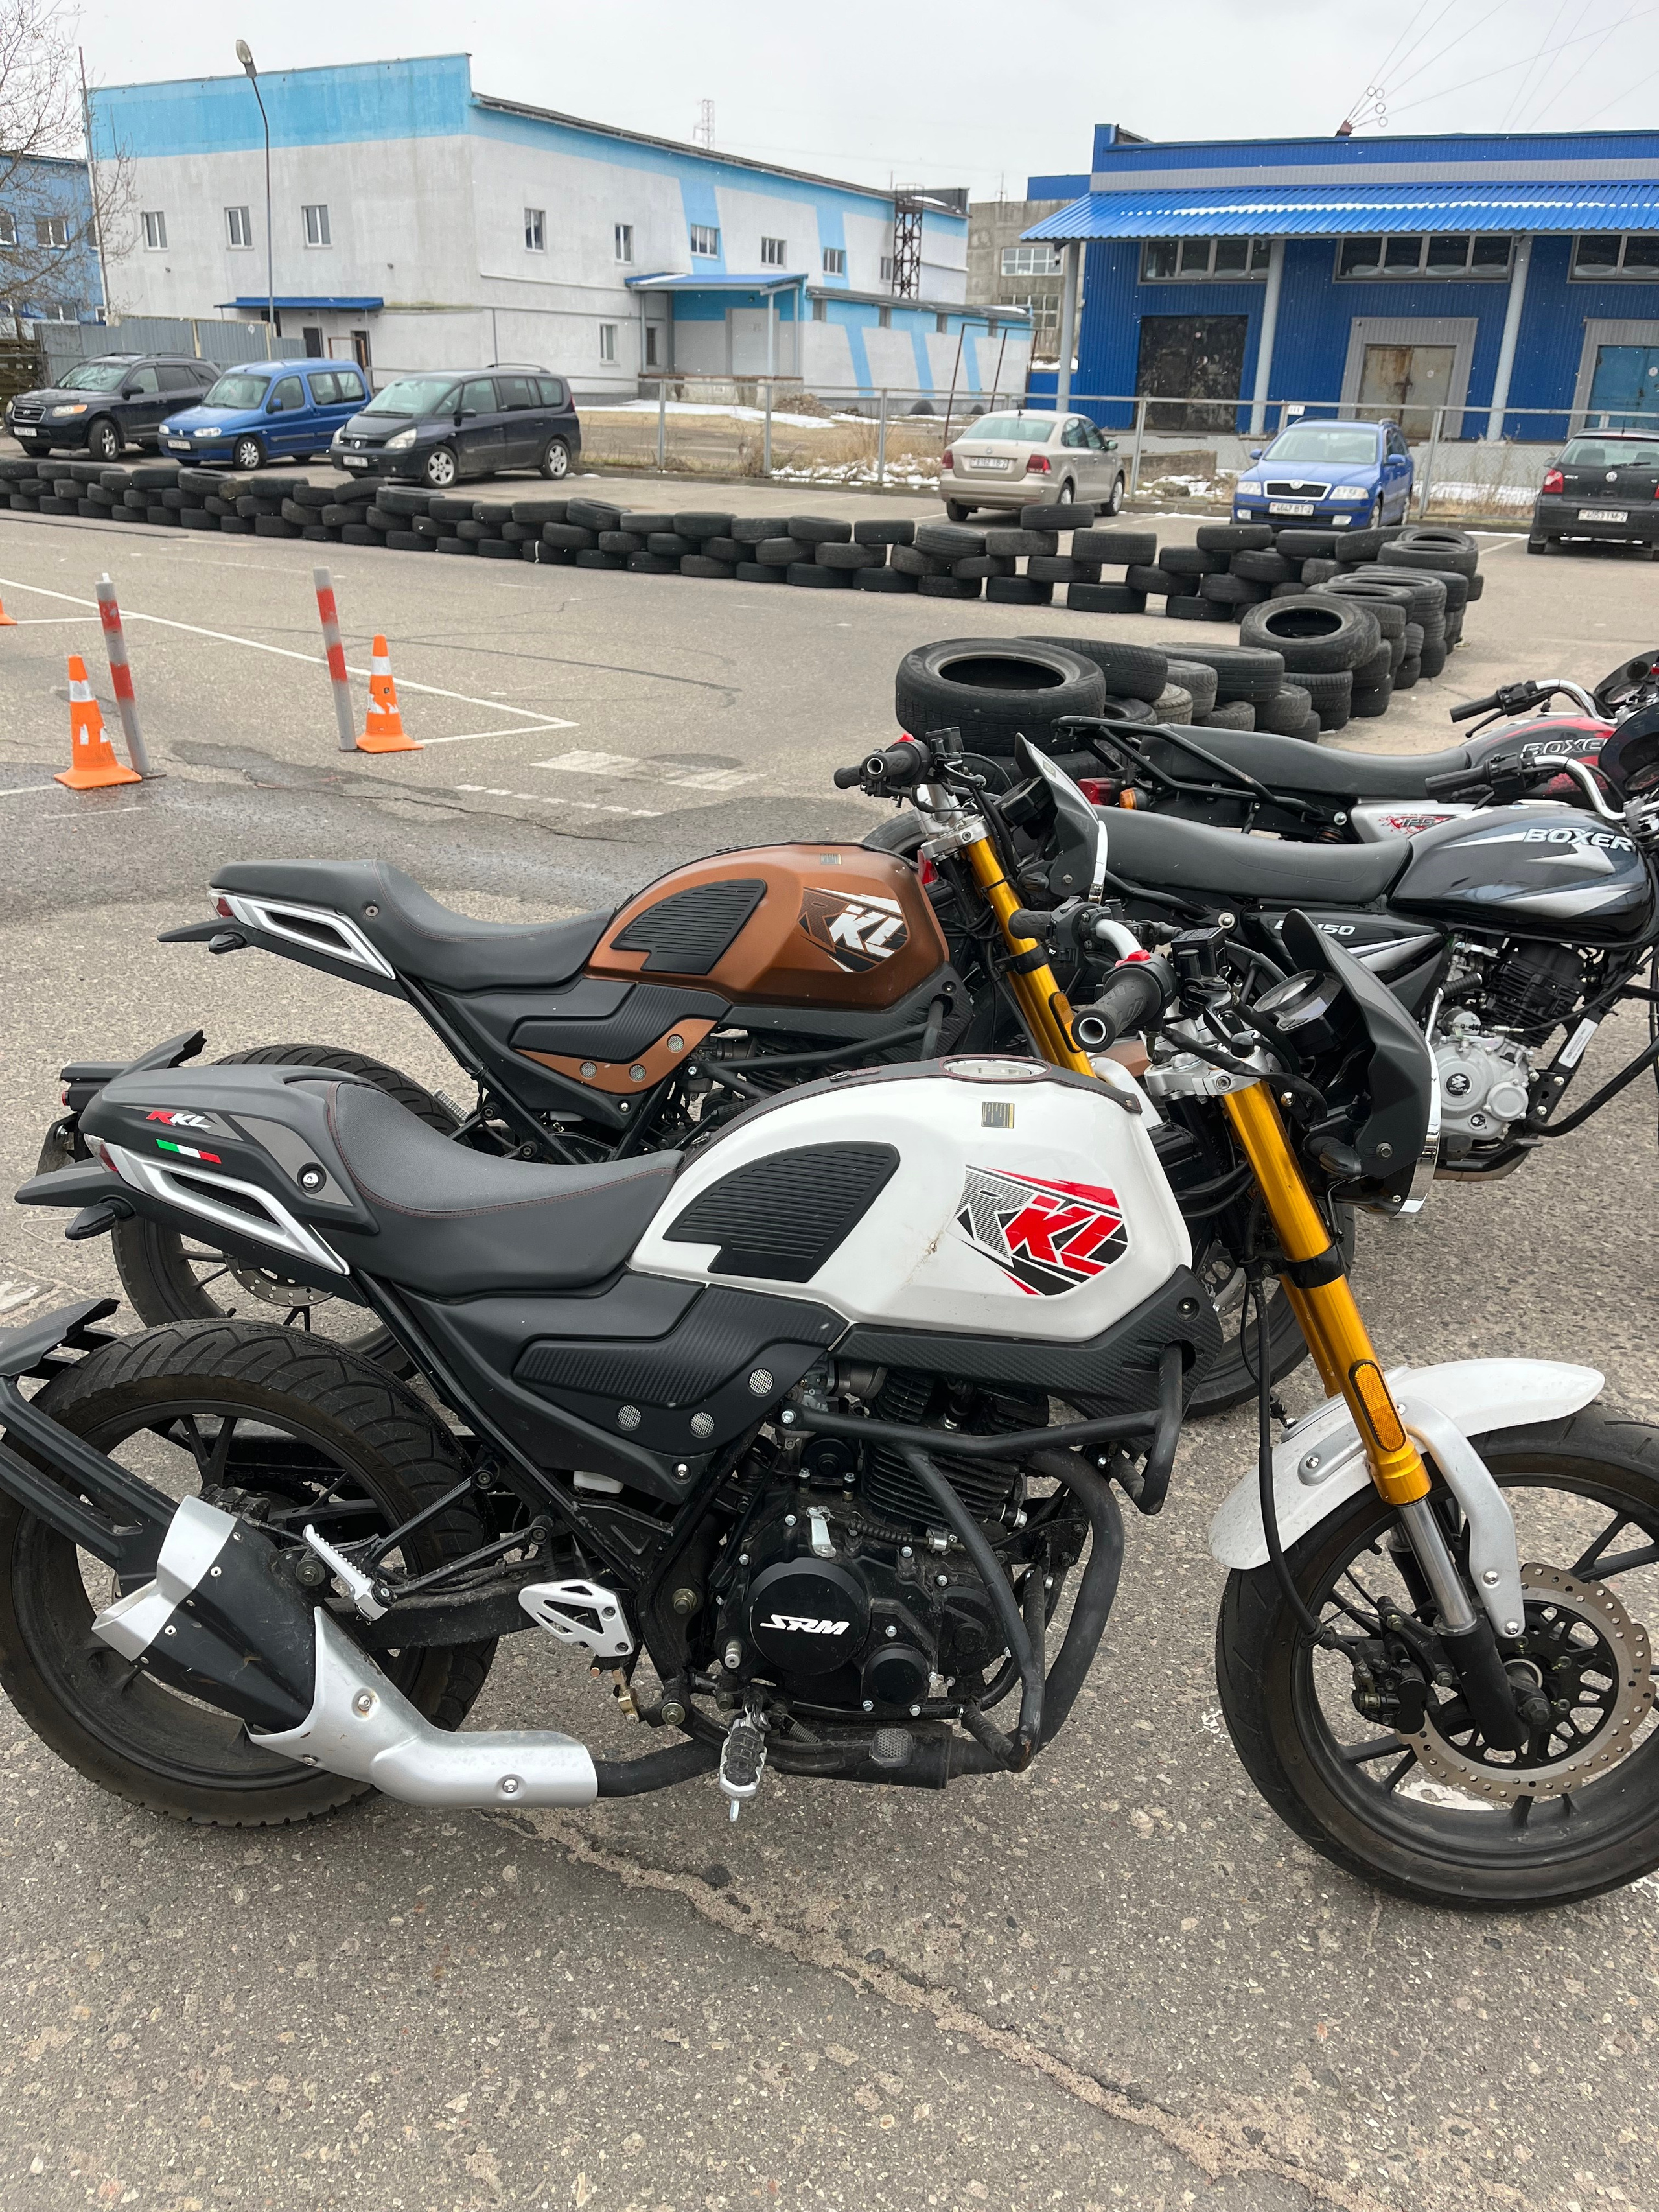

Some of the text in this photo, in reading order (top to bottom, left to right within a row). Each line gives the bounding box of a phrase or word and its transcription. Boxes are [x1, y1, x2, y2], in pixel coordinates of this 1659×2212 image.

[1520, 738, 1608, 758] BOXE
[1523, 827, 1634, 852] BOXER
[798, 889, 905, 959] RKL
[145, 1110, 211, 1128] RKL
[953, 1169, 1123, 1276] RKL
[760, 1614, 850, 1635] SRM
